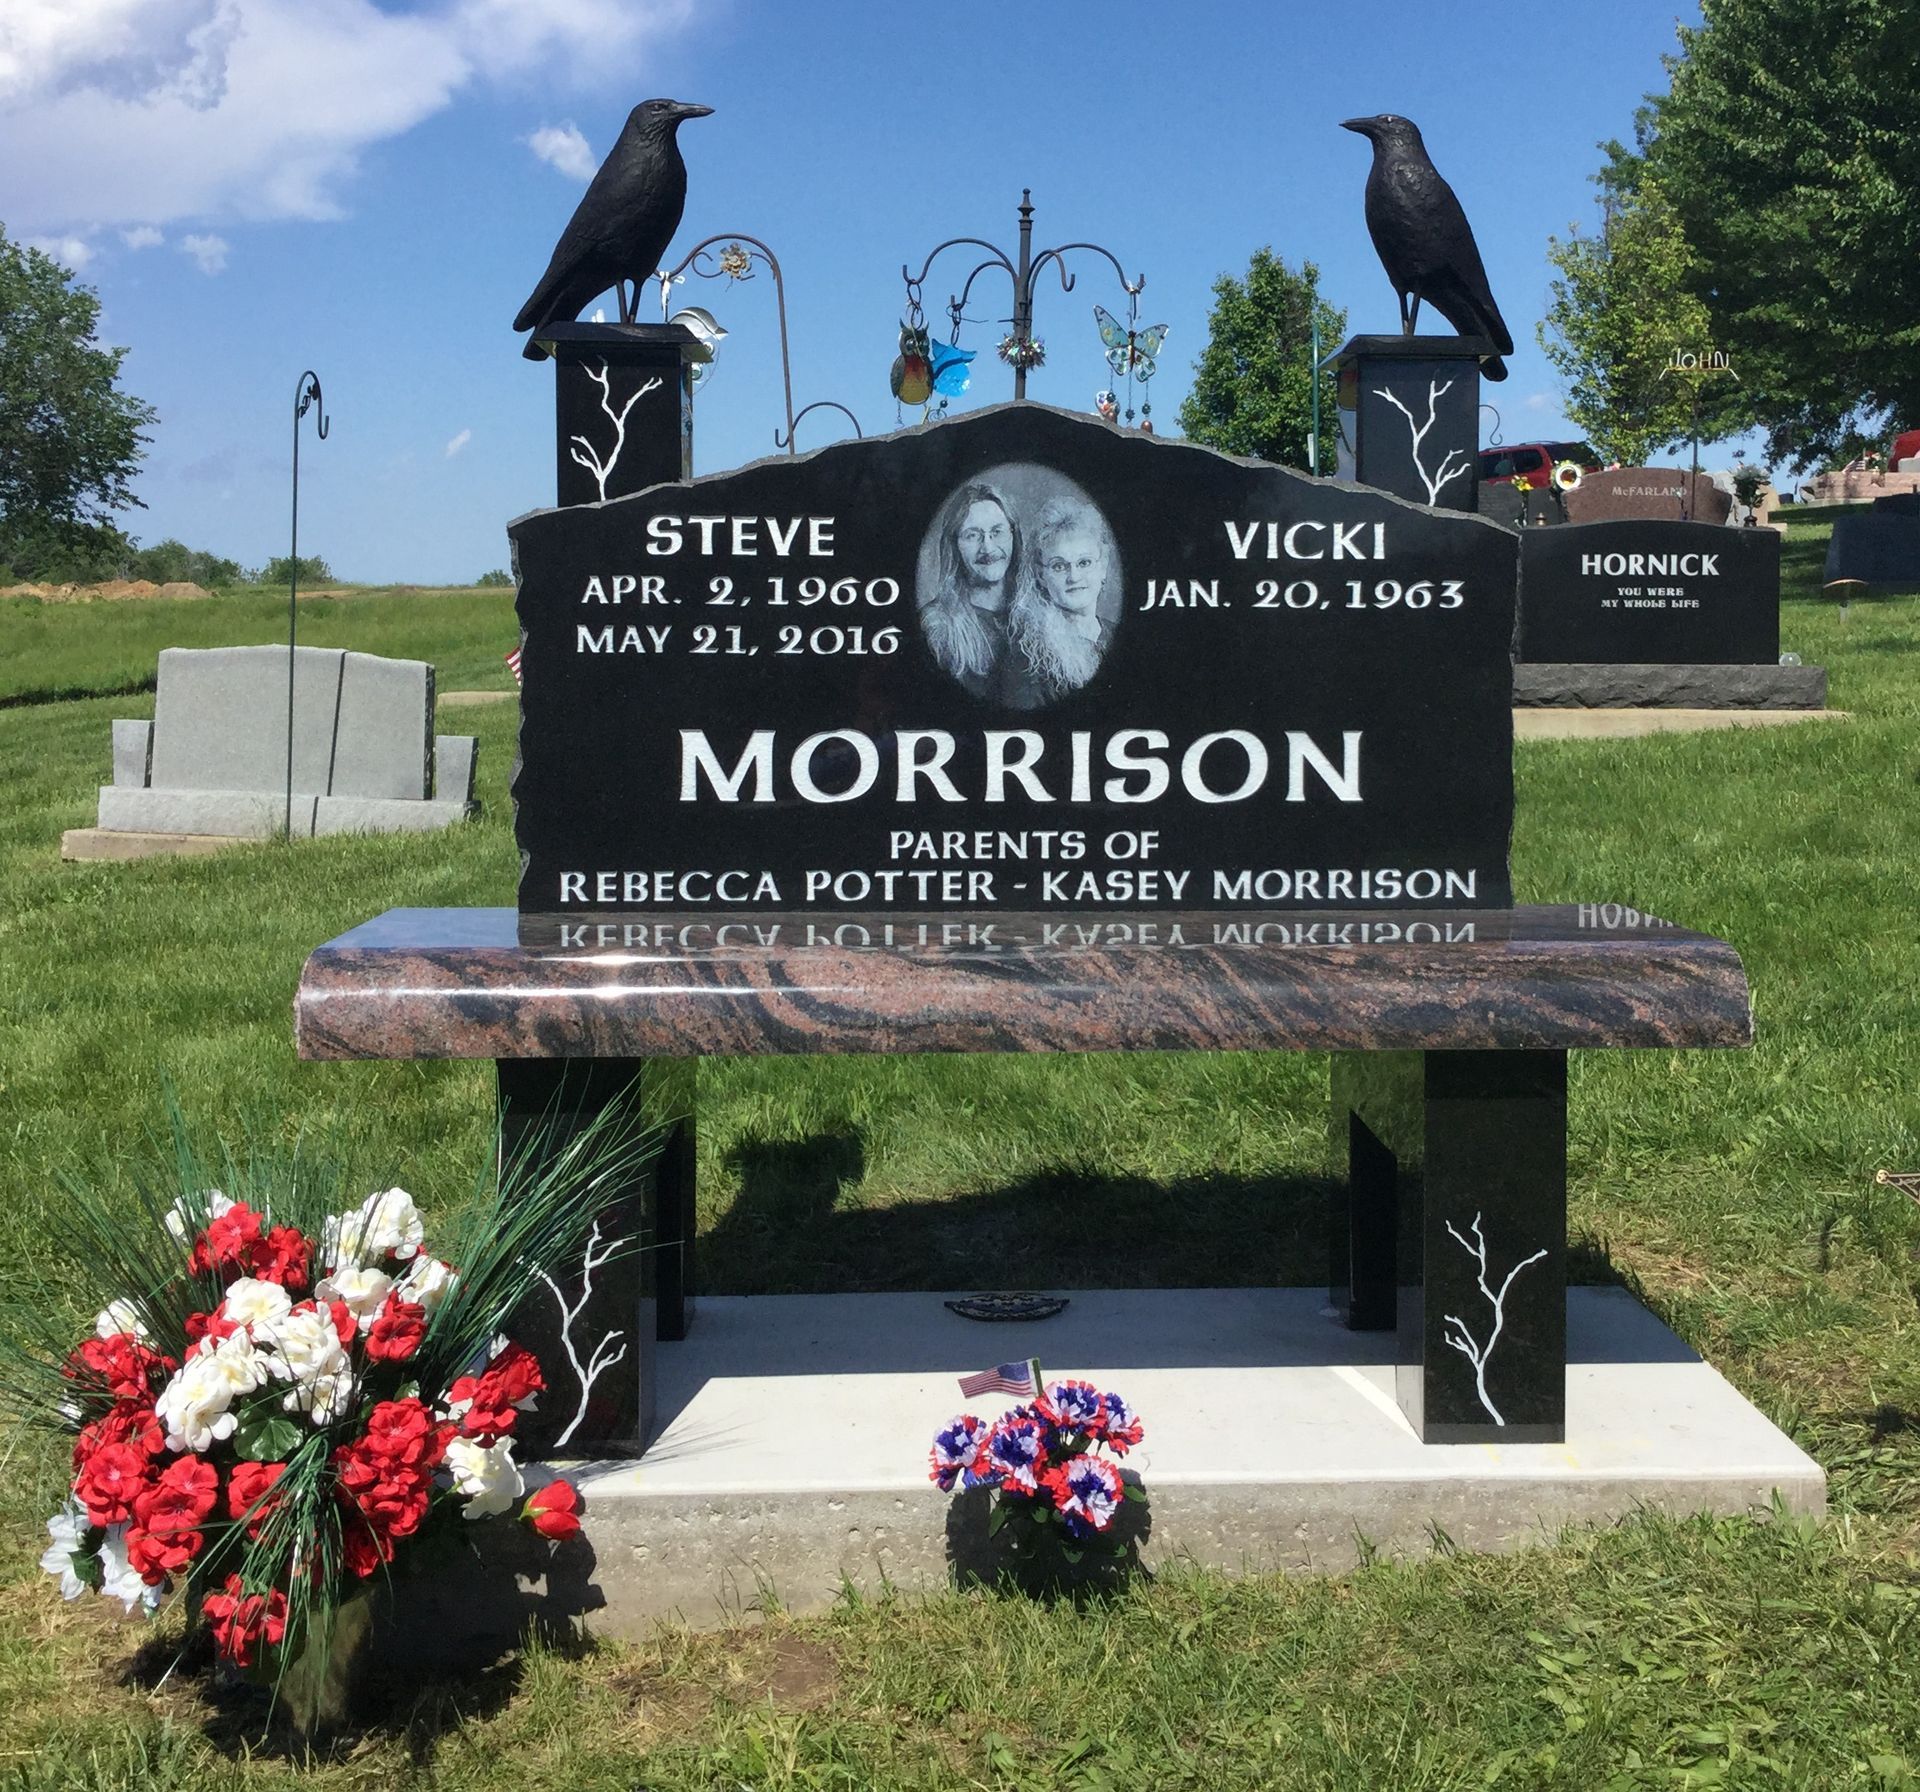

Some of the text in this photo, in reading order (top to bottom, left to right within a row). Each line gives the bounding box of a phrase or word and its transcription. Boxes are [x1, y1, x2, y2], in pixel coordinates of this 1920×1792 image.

[1668, 347, 1730, 370] JOHN
[645, 515, 836, 557] STEVE
[1224, 520, 1387, 561] VICKI
[1581, 552, 1720, 577] HORNICK
[581, 575, 901, 608] APR. 2, 1960
[1138, 578, 1466, 611] JAN. 20, 1963
[1600, 599, 1701, 608] MY WHOLE LIFE
[1617, 587, 1684, 597] YOU WERE
[576, 624, 902, 656] MAY 21, 2016
[678, 728, 1364, 804] MORRISON
[890, 830, 1160, 860] PARENTS OF
[559, 870, 782, 903] REBECCA
[805, 870, 998, 902] POTTER
[1042, 870, 1191, 901] KASEY
[1213, 869, 1478, 900] MORRISON
